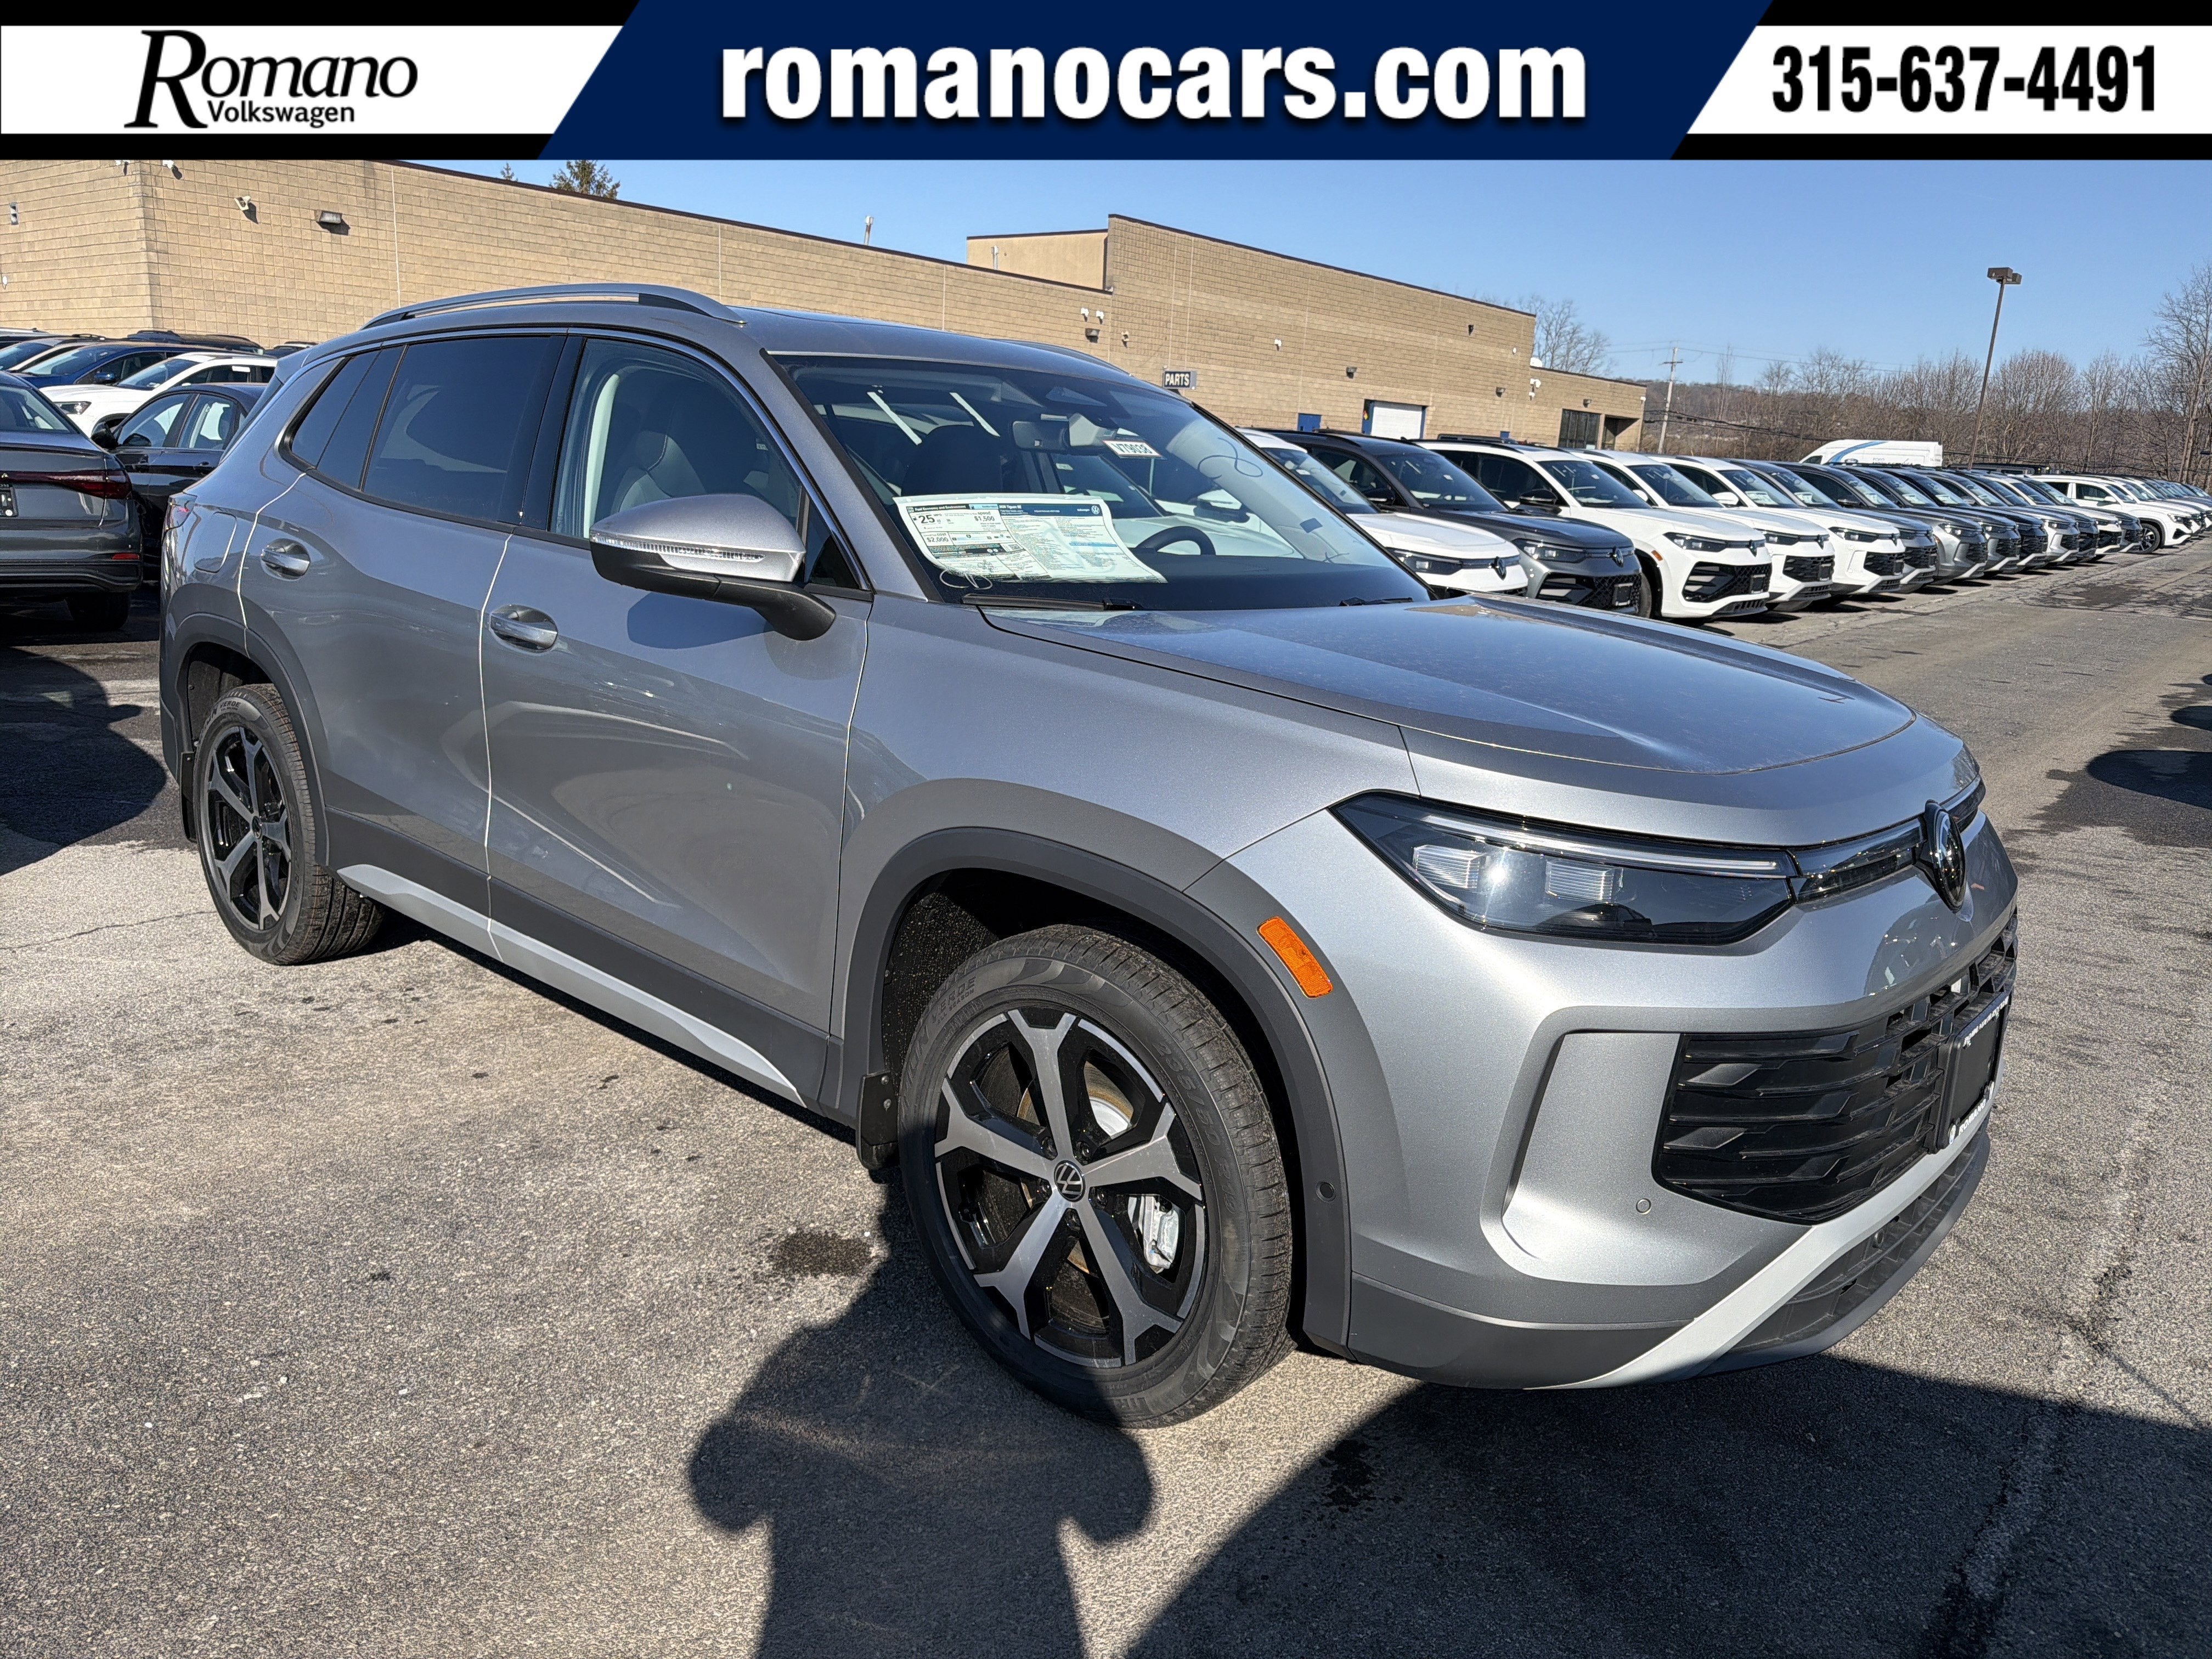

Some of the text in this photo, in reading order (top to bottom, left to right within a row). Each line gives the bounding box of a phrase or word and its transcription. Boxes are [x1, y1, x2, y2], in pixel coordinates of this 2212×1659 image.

[1165, 373, 1190, 386] PARTS
[918, 515, 935, 524] 25
[933, 976, 976, 1023] VERDE
[1958, 1098, 1987, 1137] ROMANO
